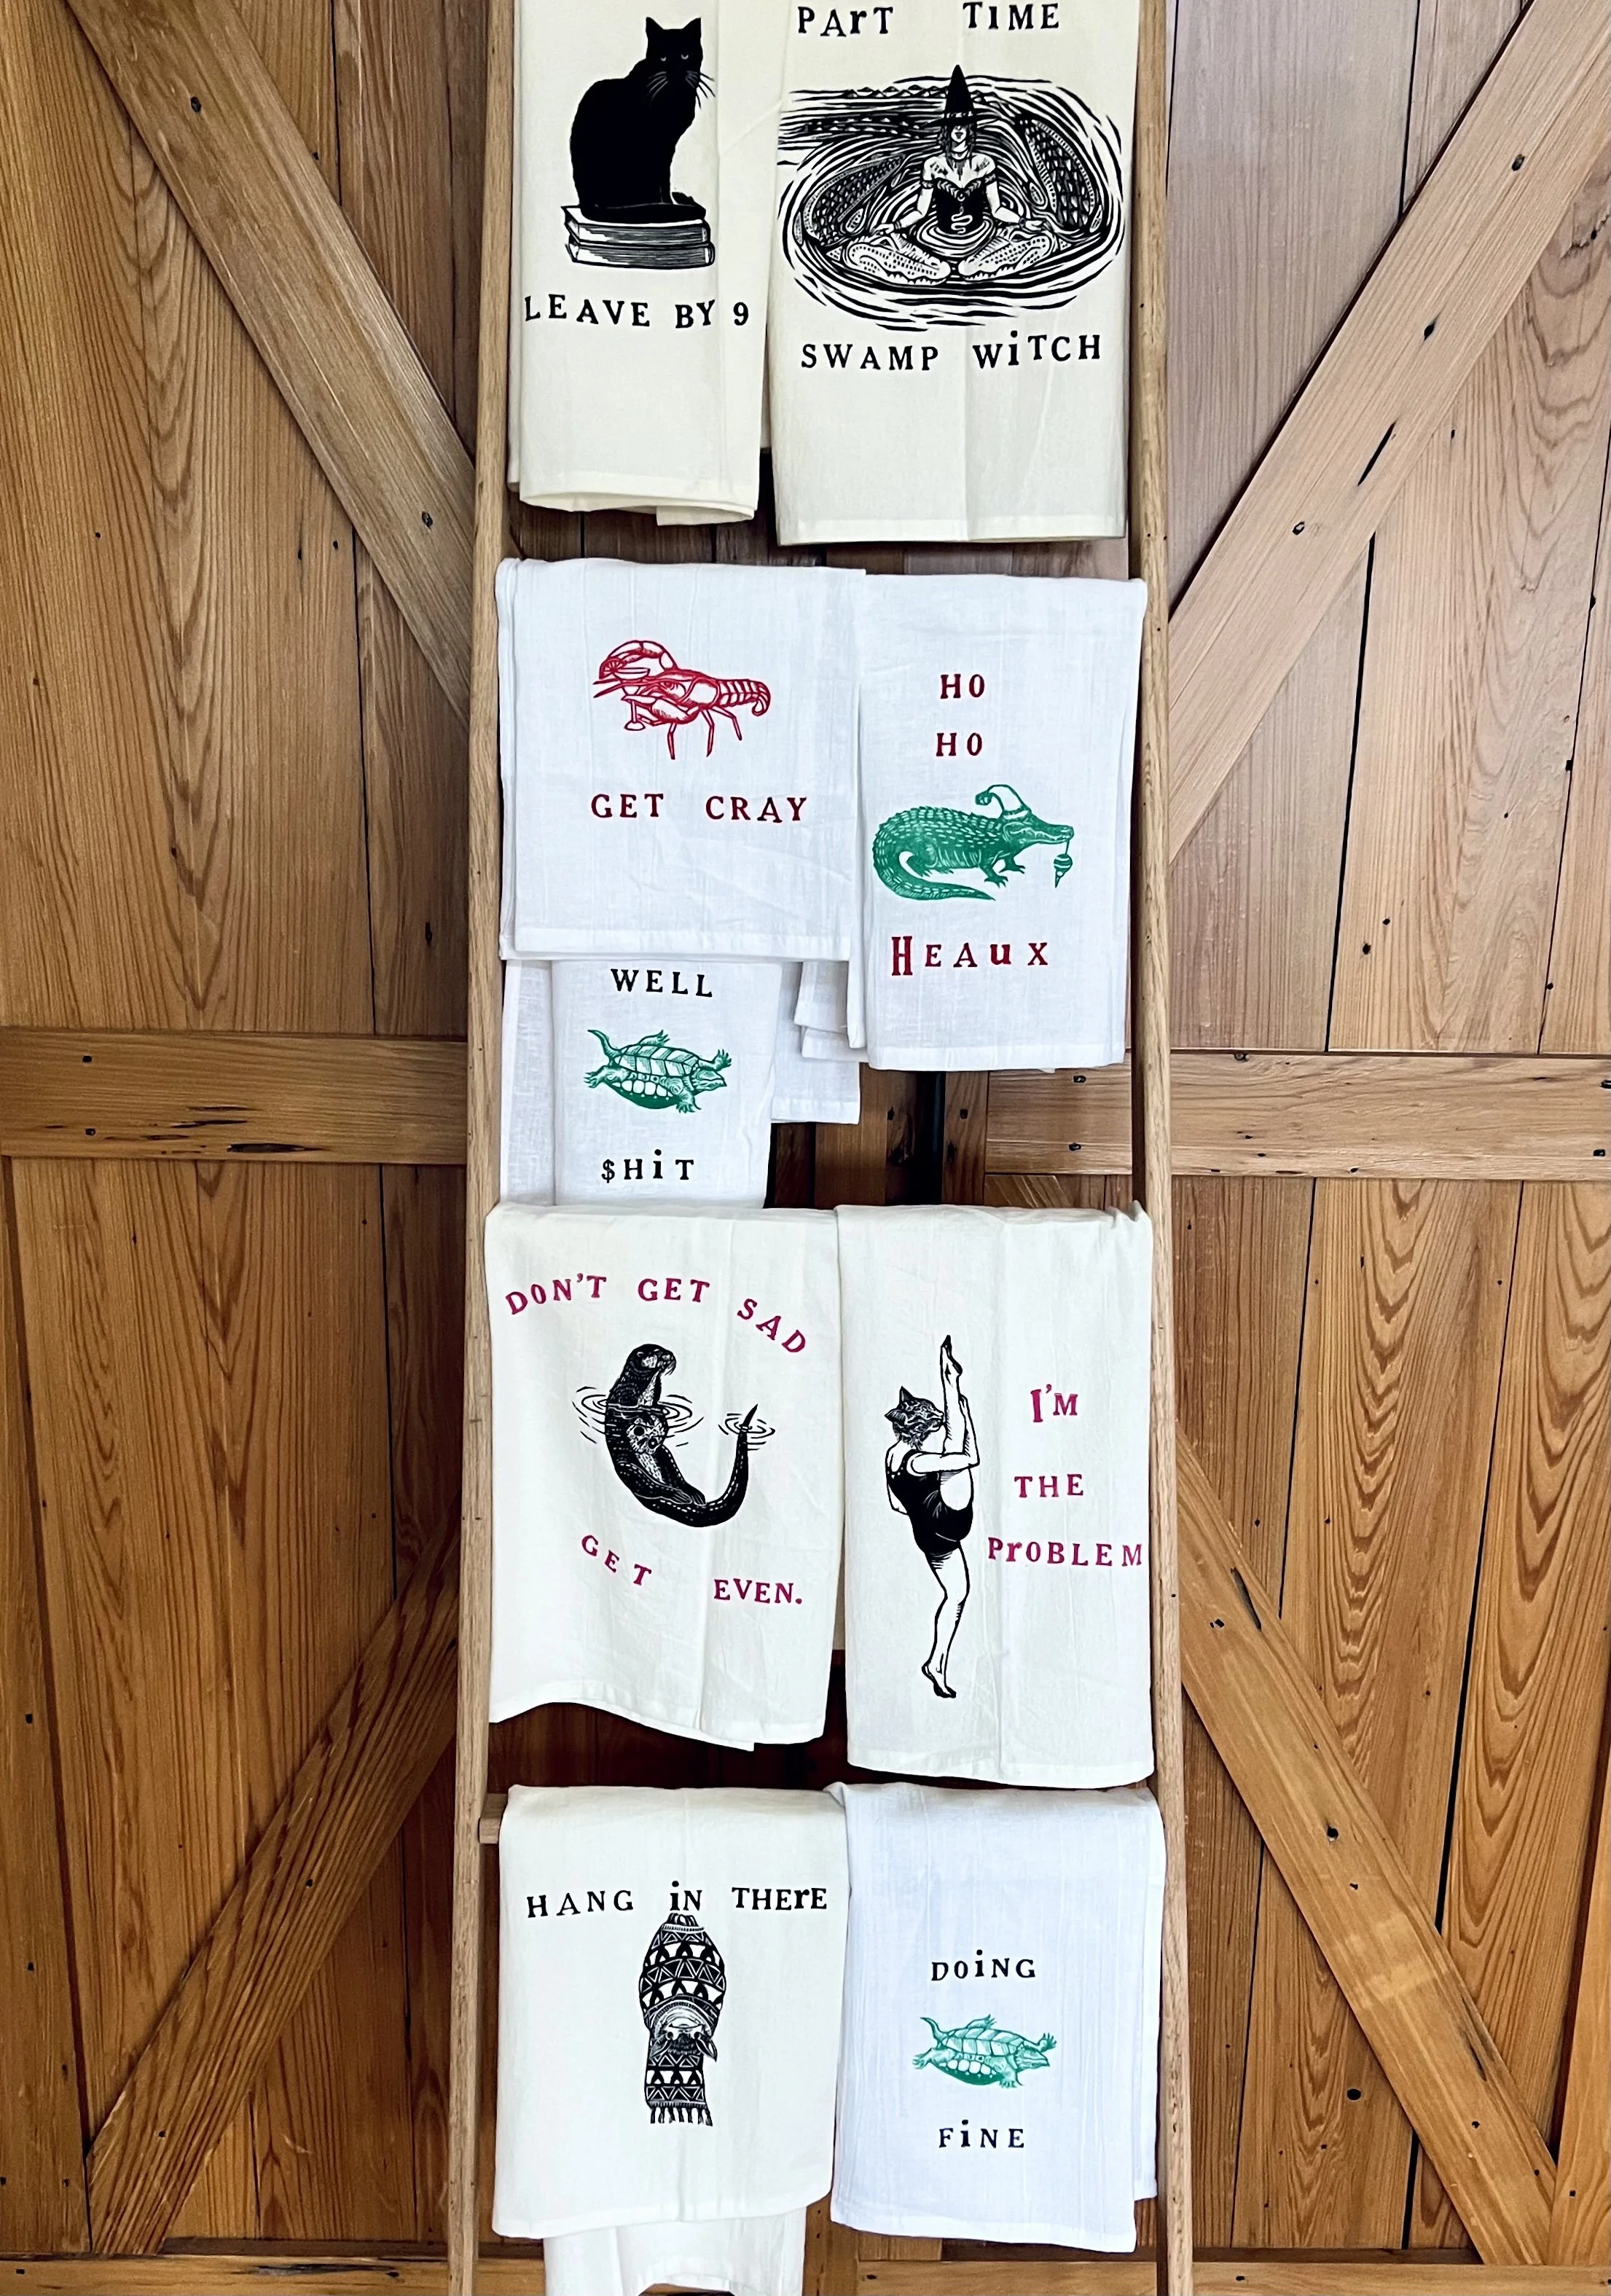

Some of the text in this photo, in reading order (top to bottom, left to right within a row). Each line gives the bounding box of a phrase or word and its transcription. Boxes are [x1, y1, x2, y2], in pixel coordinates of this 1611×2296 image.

[524, 294, 749, 329] LEAVE BY 9
[801, 343, 938, 371] SWAMP
[940, 673, 985, 700] HO
[936, 732, 983, 757] HO
[591, 793, 807, 823] GET CRAY
[610, 968, 713, 998] WELL
[505, 1273, 806, 1353] DON'T GET SAD
[1030, 1384, 1078, 1423] I'M
[1014, 1473, 1083, 1498] THE
[581, 1535, 802, 1605] GET EVEN.
[526, 1889, 634, 1919] HANG
